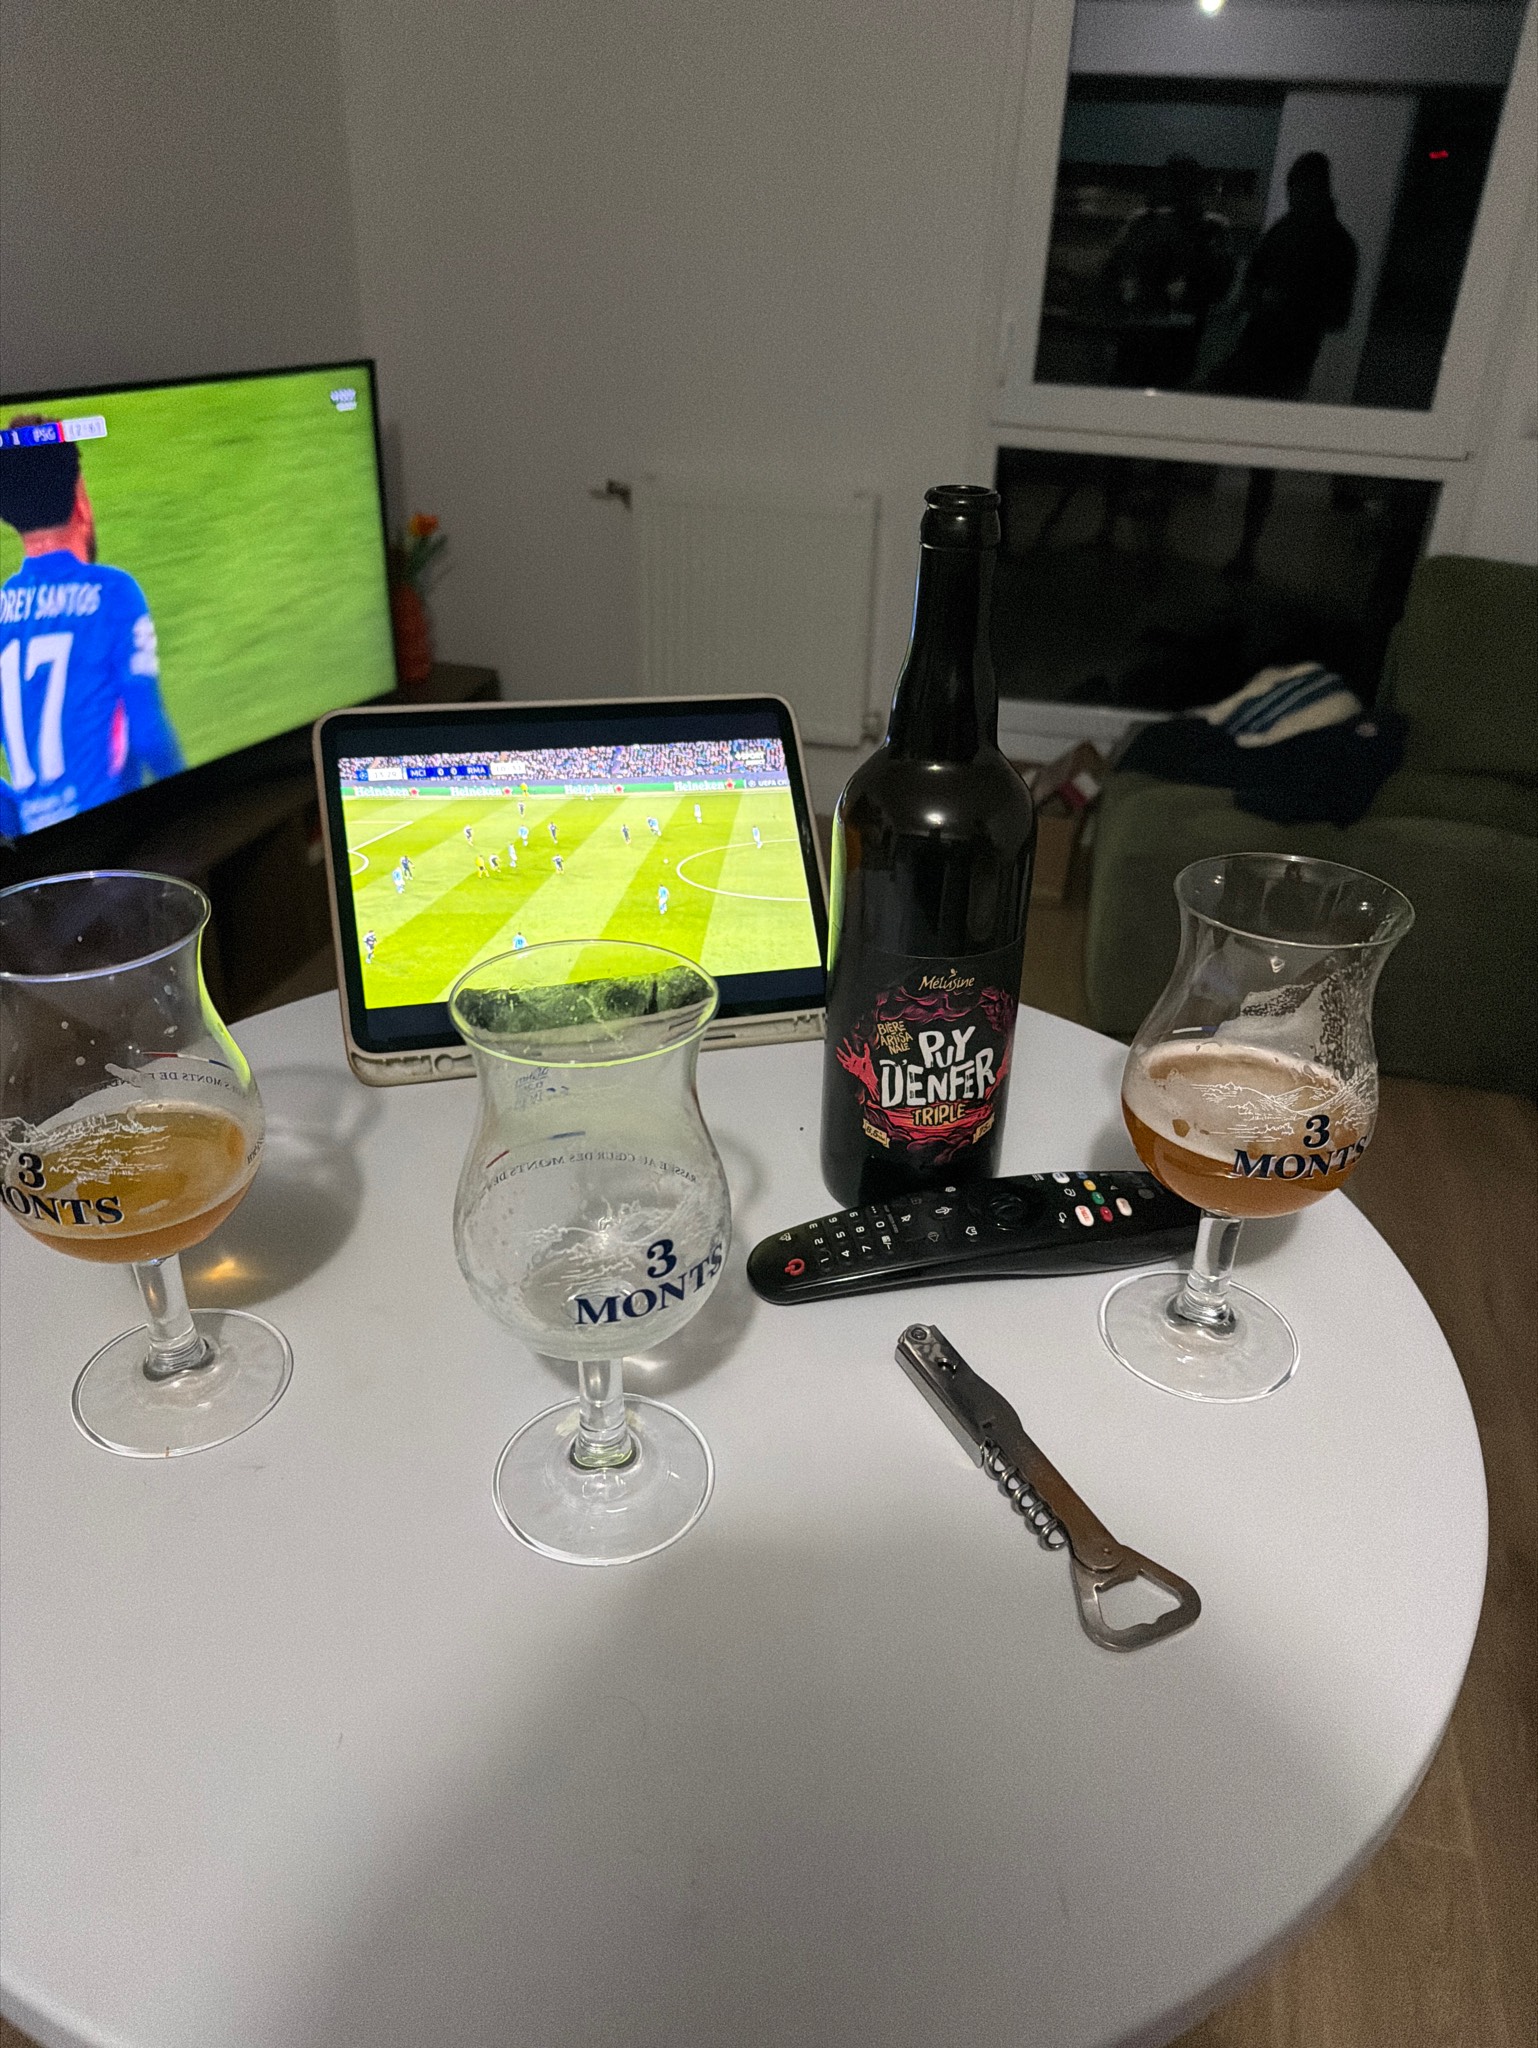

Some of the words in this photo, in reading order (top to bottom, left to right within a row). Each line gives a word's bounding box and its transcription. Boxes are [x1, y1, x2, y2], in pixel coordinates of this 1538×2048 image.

[32, 425, 57, 443] PSG
[34, 582, 102, 620] SANTOS
[0, 632, 74, 791] 17
[410, 769, 427, 777] MCI
[436, 767, 445, 776] 0
[449, 766, 458, 775] 0
[466, 765, 486, 775] RMA
[355, 785, 409, 797] Heineken
[450, 785, 501, 797] Heineken
[673, 780, 725, 792] Heineken
[757, 779, 776, 787] UEFA
[918, 974, 976, 991] Mélusine
[877, 1020, 907, 1035] BIÈRE
[889, 1042, 911, 1056] NALE
[918, 1026, 976, 1069] PUY
[879, 1047, 997, 1108] D'ENFER
[913, 1103, 966, 1126] TRIPLE
[1302, 1113, 1331, 1149] 3
[1230, 1136, 1369, 1181] MONTS
[18, 1152, 46, 1189] 3
[0, 1183, 124, 1226] ONTS
[809, 1222, 818, 1230] 3
[814, 1237, 824, 1246] 2
[835, 1231, 846, 1239] 5
[841, 1249, 850, 1257] 4
[861, 1245, 871, 1253] 7
[647, 1238, 678, 1279] 3
[574, 1243, 724, 1326] MONTS
